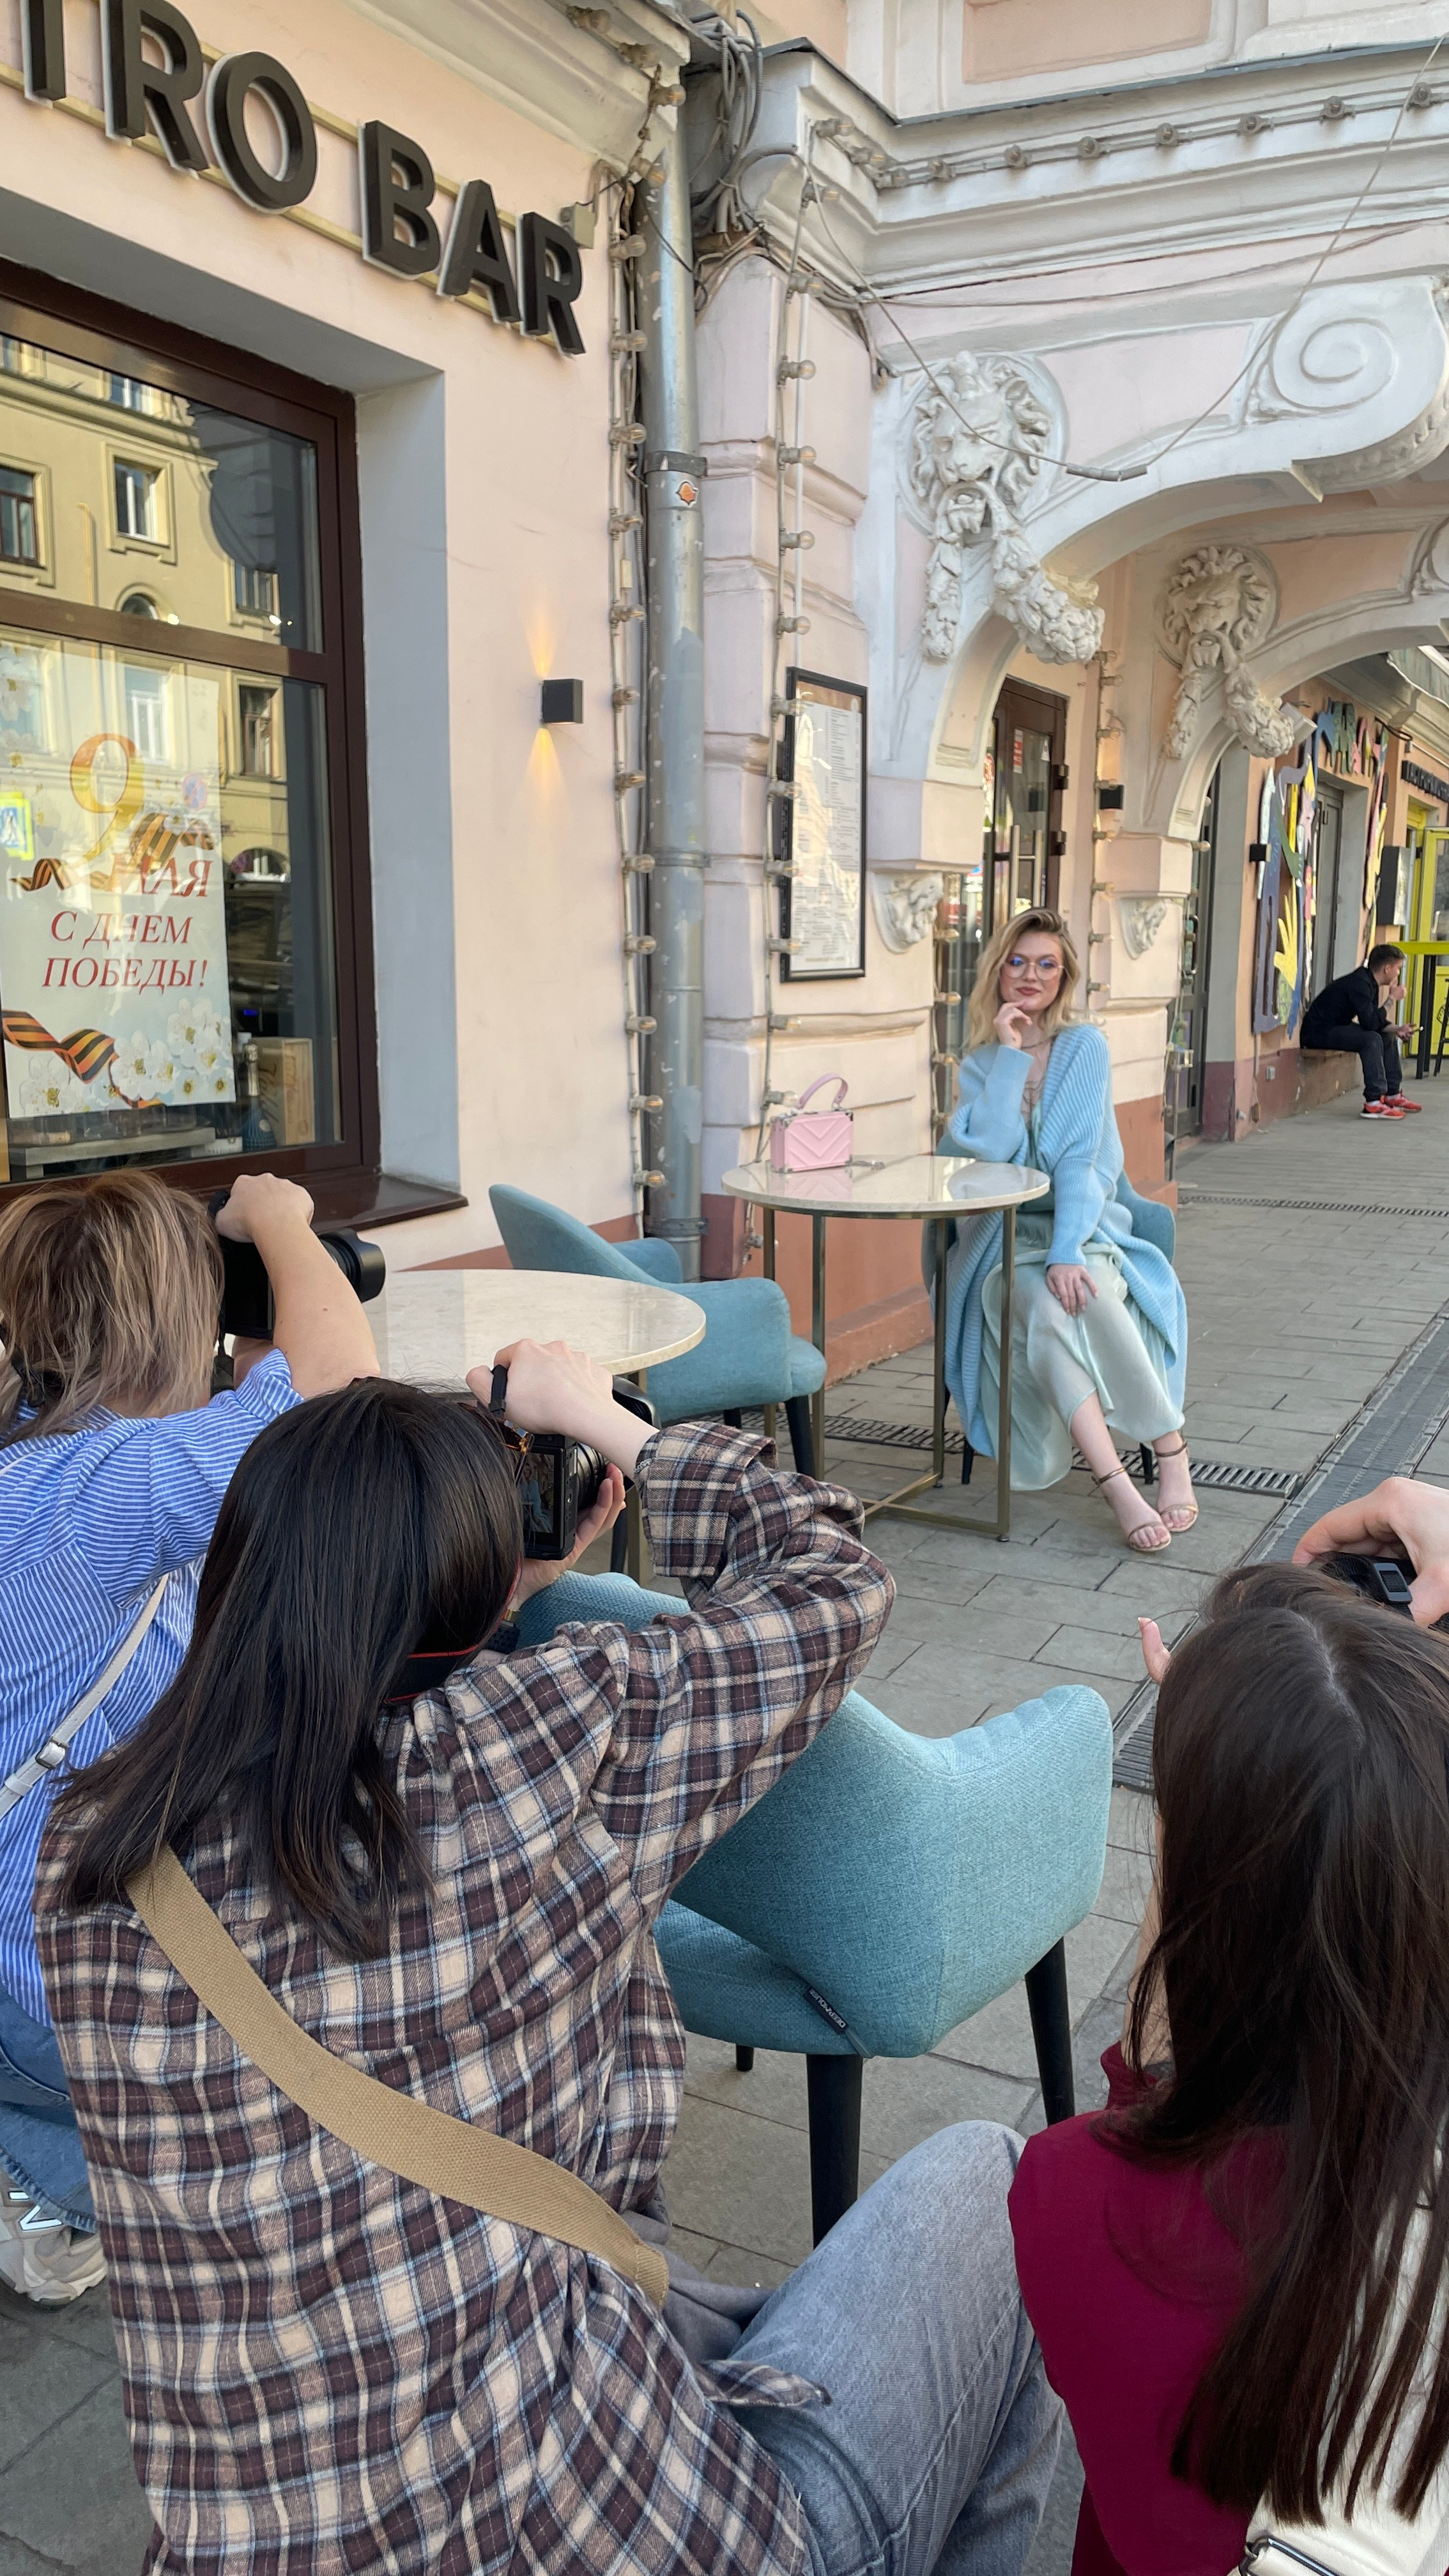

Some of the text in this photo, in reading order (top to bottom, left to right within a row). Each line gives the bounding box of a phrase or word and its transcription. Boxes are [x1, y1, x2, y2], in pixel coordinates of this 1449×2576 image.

[360, 120, 586, 358] BAR
[70, 733, 145, 861] 9
[51, 910, 194, 950] С ДНЕМ
[42, 957, 209, 995] ПОБЕДЫ!
